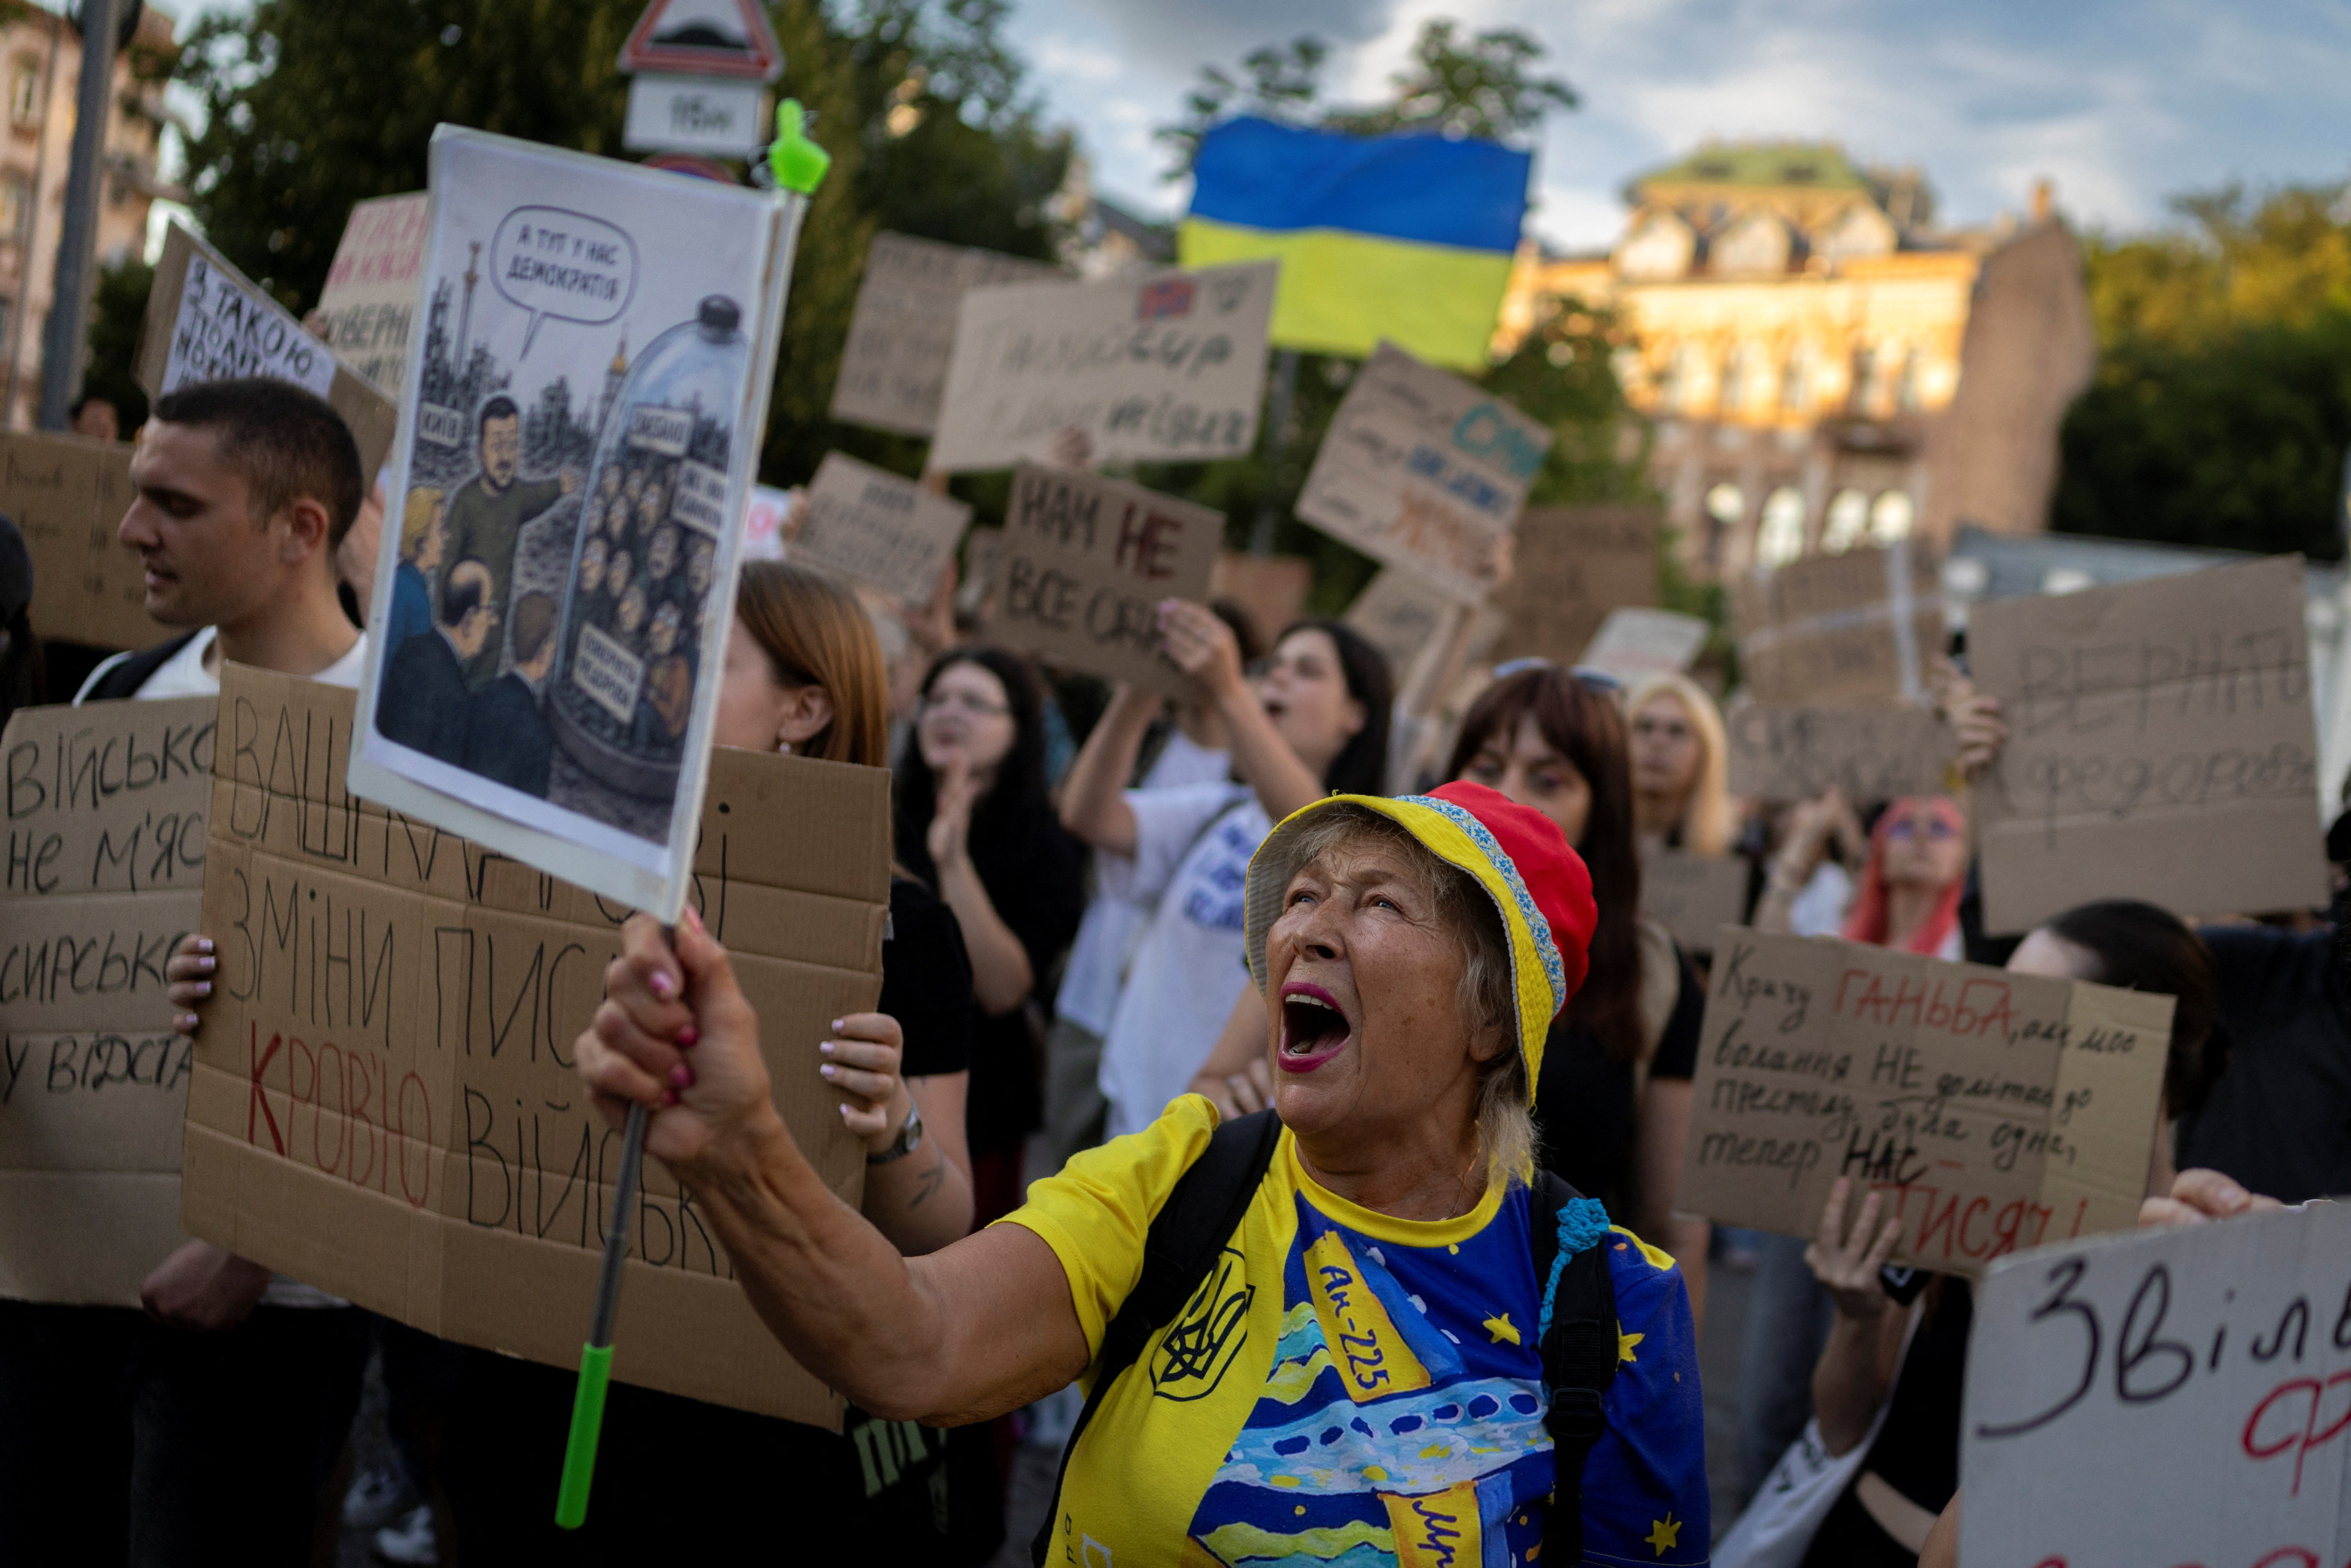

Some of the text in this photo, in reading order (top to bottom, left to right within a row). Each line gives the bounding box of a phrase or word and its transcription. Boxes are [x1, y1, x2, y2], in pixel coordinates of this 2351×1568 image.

[506, 254, 619, 301] ДЕМОКРАТІЯ
[517, 224, 531, 245] А
[537, 228, 567, 254] ТУТ
[585, 242, 619, 268] НАС
[215, 280, 313, 378] ТАКОЮ
[1113, 499, 1188, 581] НЕ
[6, 719, 216, 820] ВІЙСЬКО
[92, 808, 207, 893] М'ЯС
[435, 926, 619, 1069] ПИС
[46, 1029, 193, 1094] ВІДСТА
[1870, 1041, 1925, 1088] НЕ
[248, 1019, 430, 1208] КРОВ'Ю
[463, 1084, 734, 1281] ВІЙСЬК
[1841, 1125, 1929, 1186] НАС
